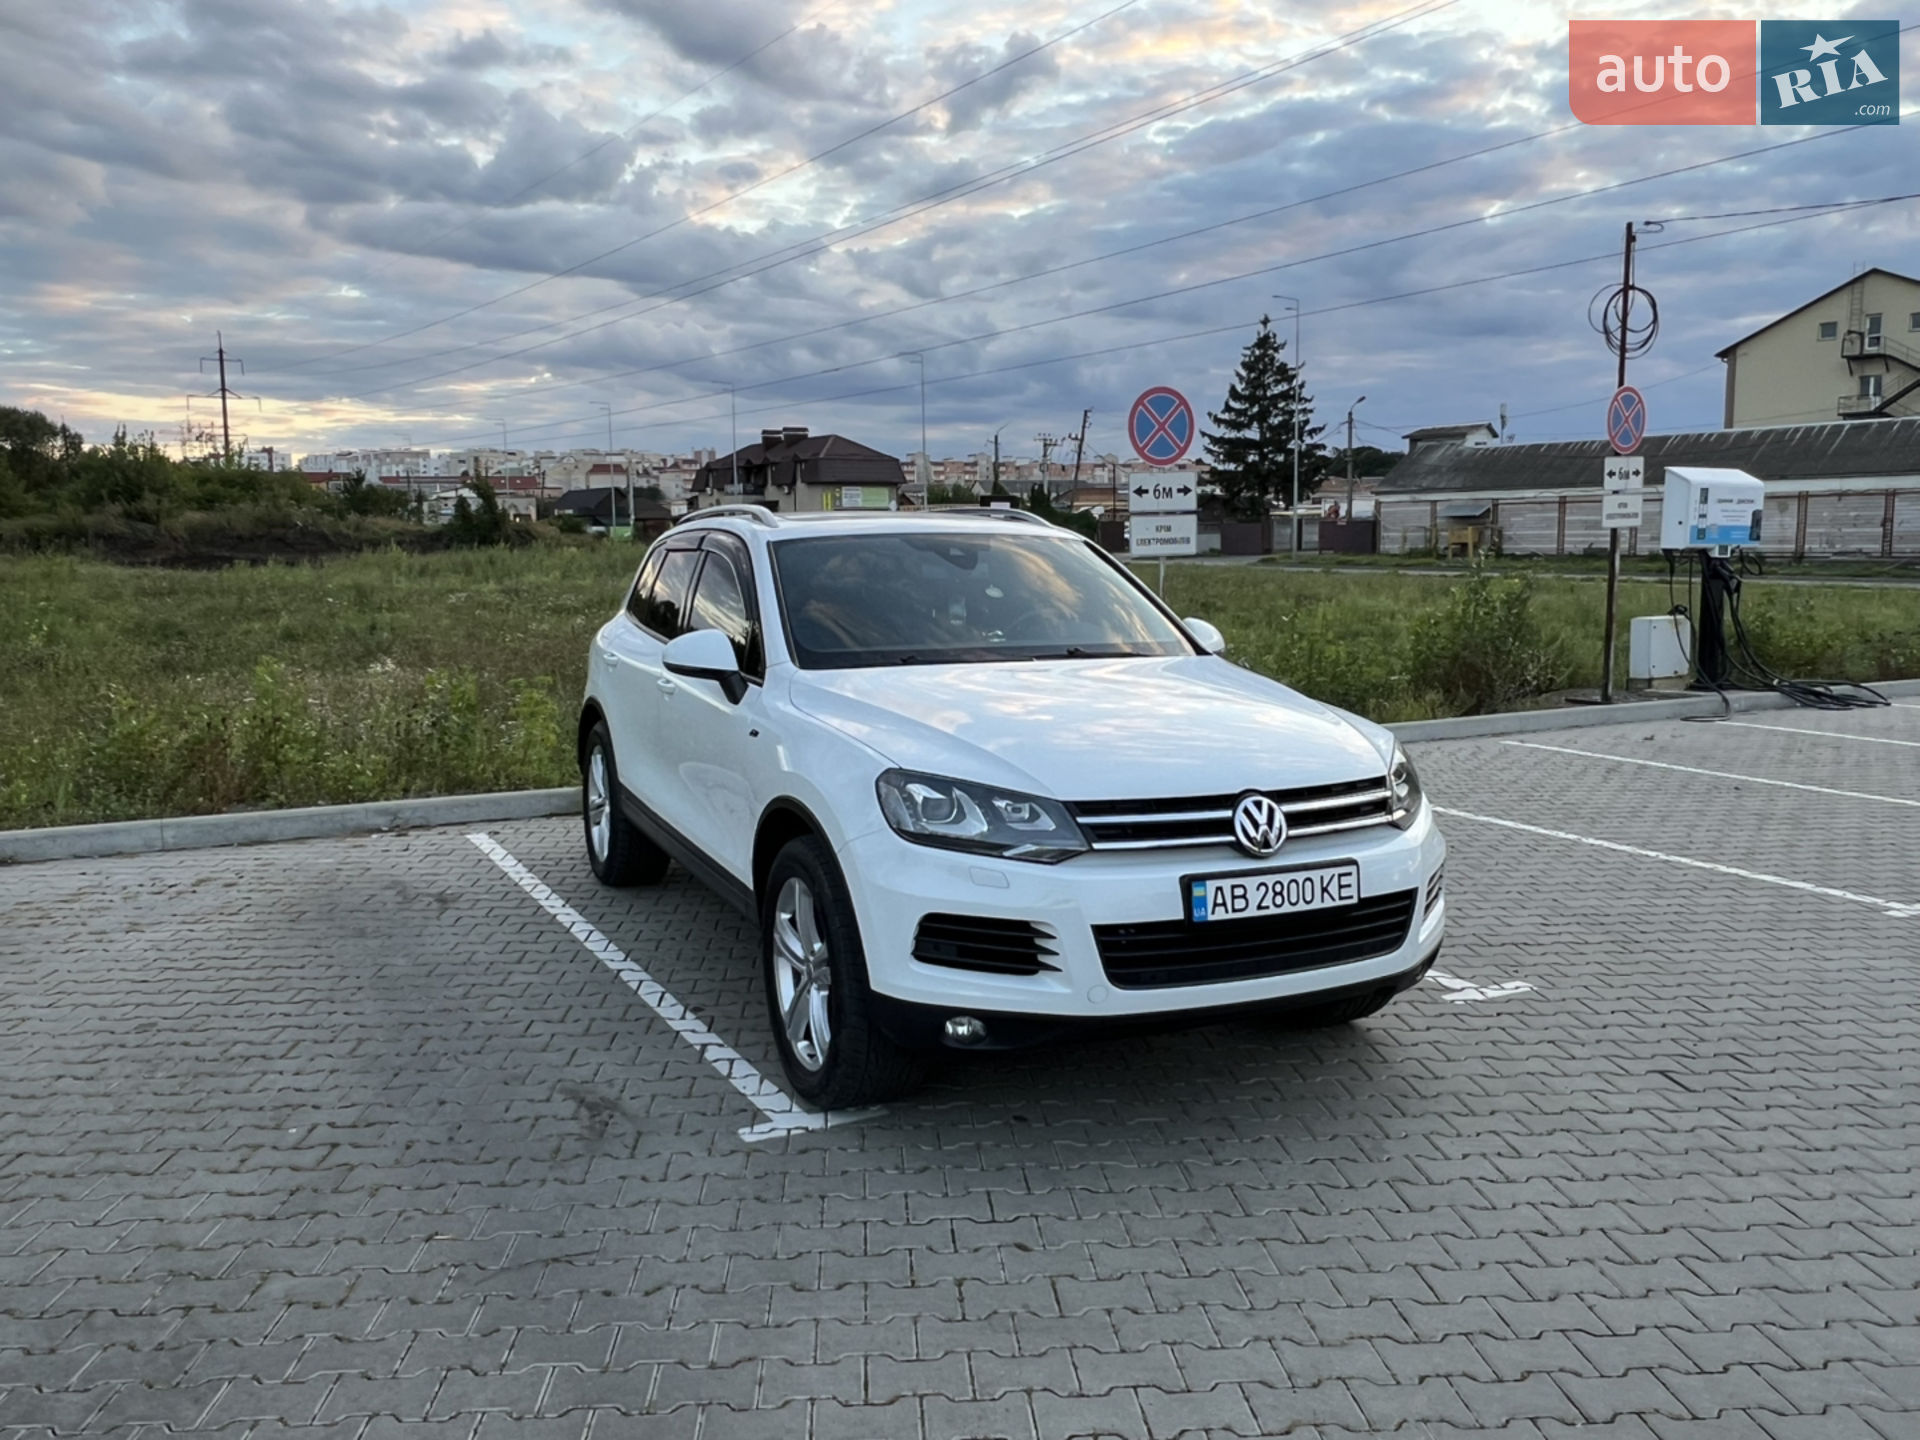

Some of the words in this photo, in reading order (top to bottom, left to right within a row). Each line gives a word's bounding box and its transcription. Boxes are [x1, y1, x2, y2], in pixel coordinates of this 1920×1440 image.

[1211, 883, 1250, 916] AB
[1256, 876, 1315, 911] 2800
[1320, 871, 1355, 904] KE
[1193, 907, 1207, 917] UA
